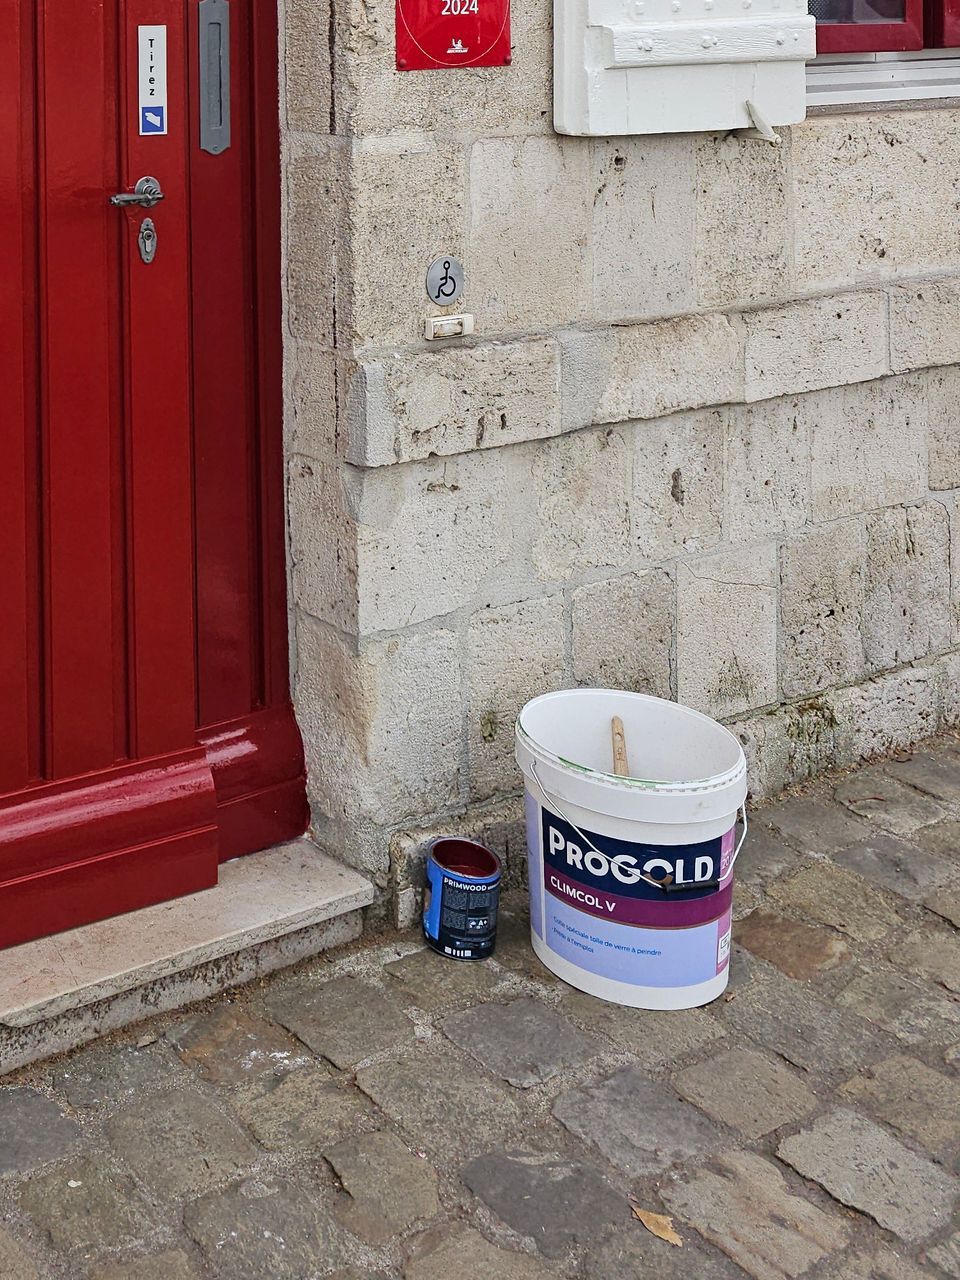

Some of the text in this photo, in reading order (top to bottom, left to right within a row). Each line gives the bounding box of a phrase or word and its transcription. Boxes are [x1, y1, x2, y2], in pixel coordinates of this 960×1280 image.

[548, 825, 714, 887] PROGOLD
[443, 877, 487, 892] PRIMWOOD
[550, 876, 616, 913] CLIMCOL V
